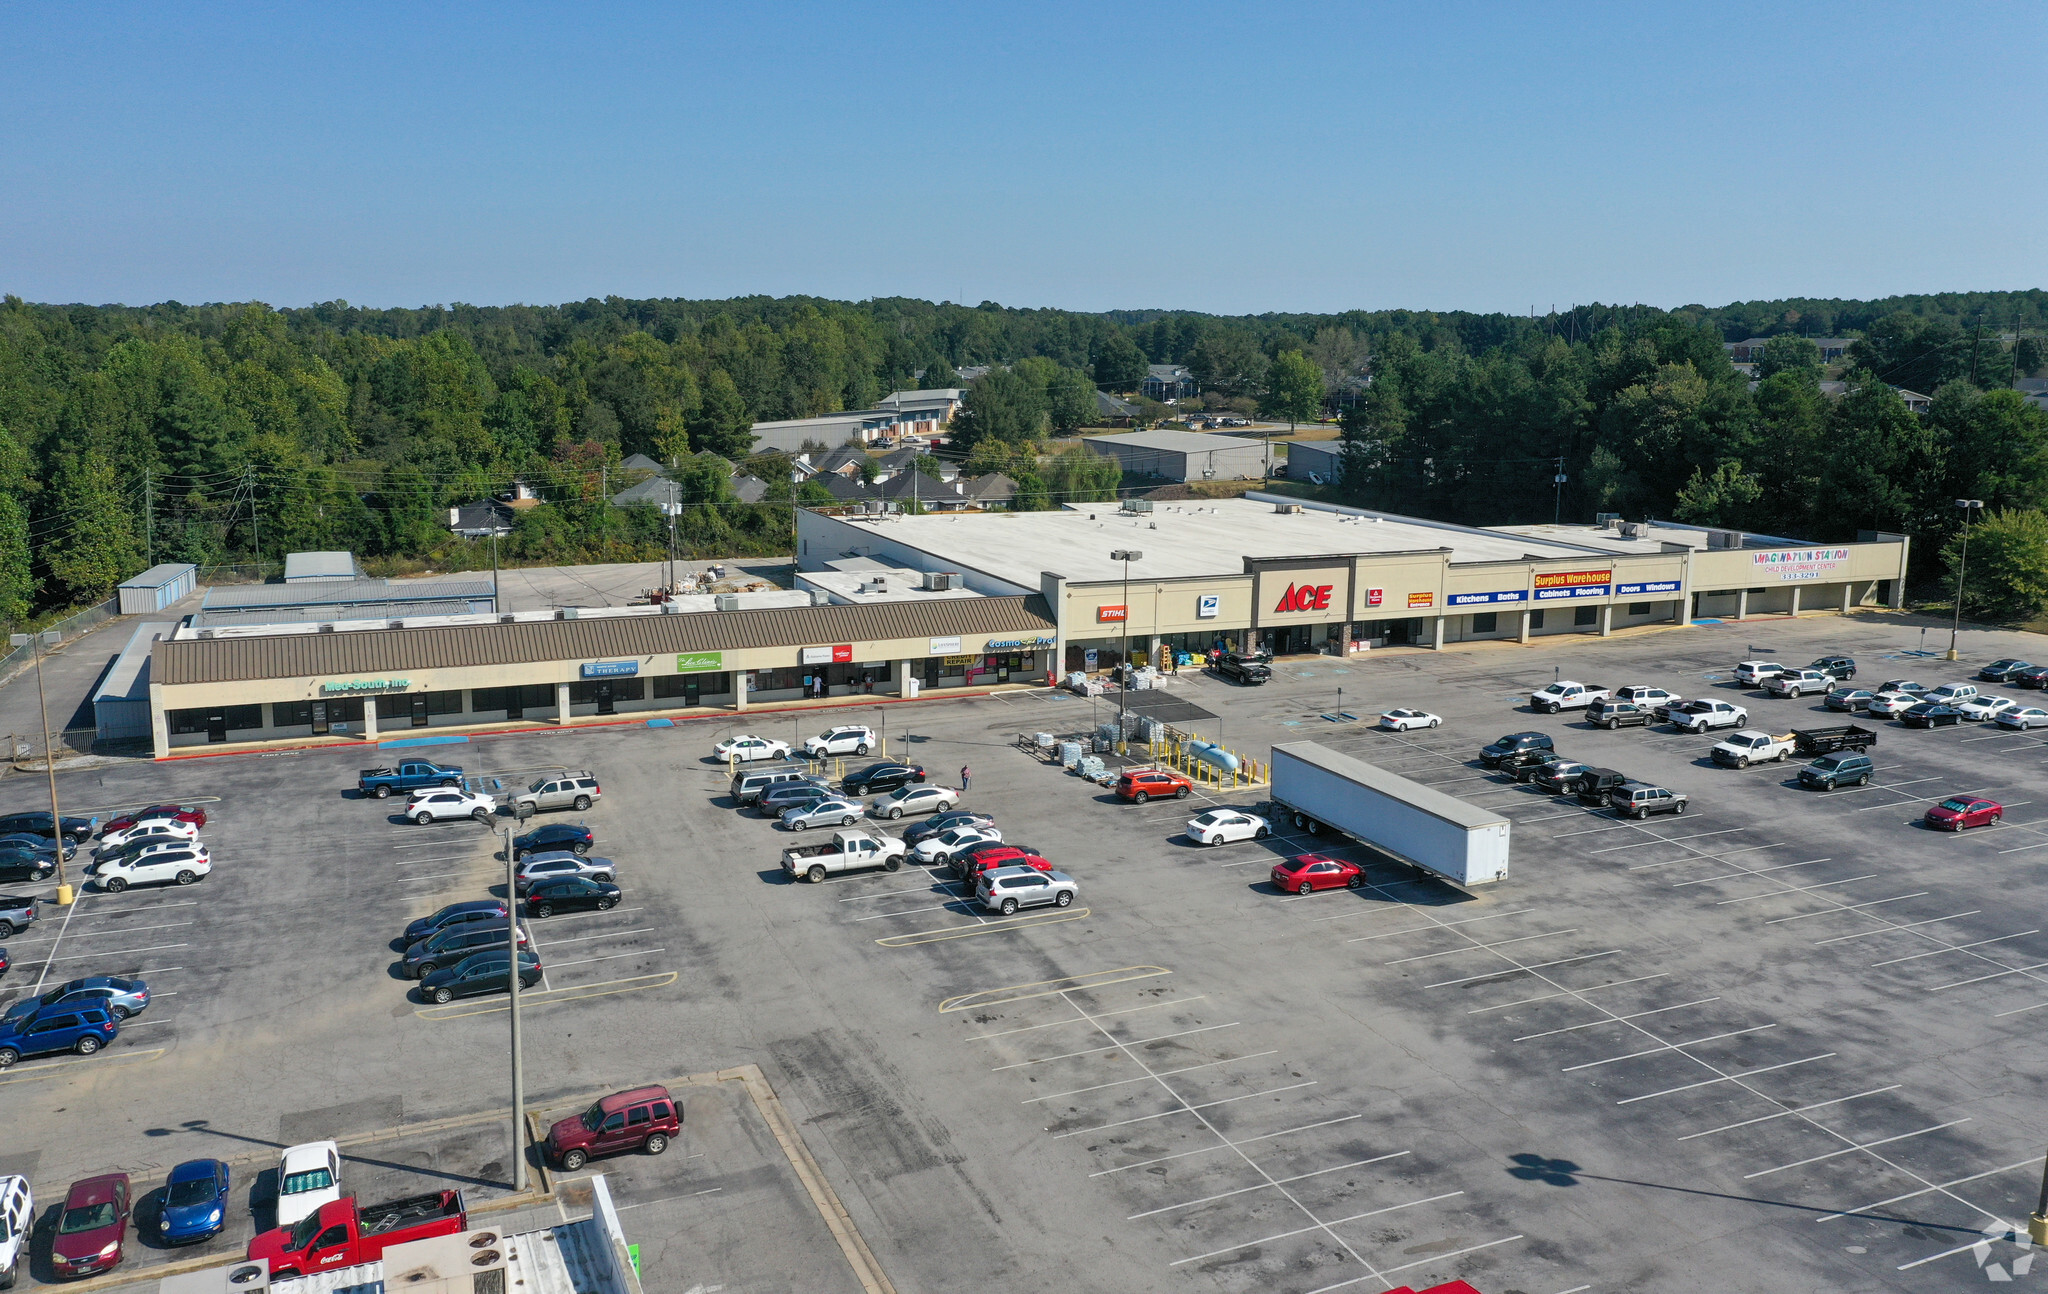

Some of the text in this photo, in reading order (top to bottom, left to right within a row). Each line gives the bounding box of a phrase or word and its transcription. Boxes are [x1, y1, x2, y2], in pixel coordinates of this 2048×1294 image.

[1754, 550, 1848, 564] IMAGINATION STATION
[1780, 564, 1816, 572] DEVELOPMENT
[1535, 572, 1611, 587] Surplus Warehouse
[1781, 572, 1819, 580] 333-3291
[1539, 587, 1604, 598] Cabinets Flooring
[1621, 583, 1675, 593] Doors Windows
[1275, 582, 1334, 612] ACE
[1456, 593, 1520, 603] Kitchens Baths
[988, 639, 1021, 648] Cosmo
